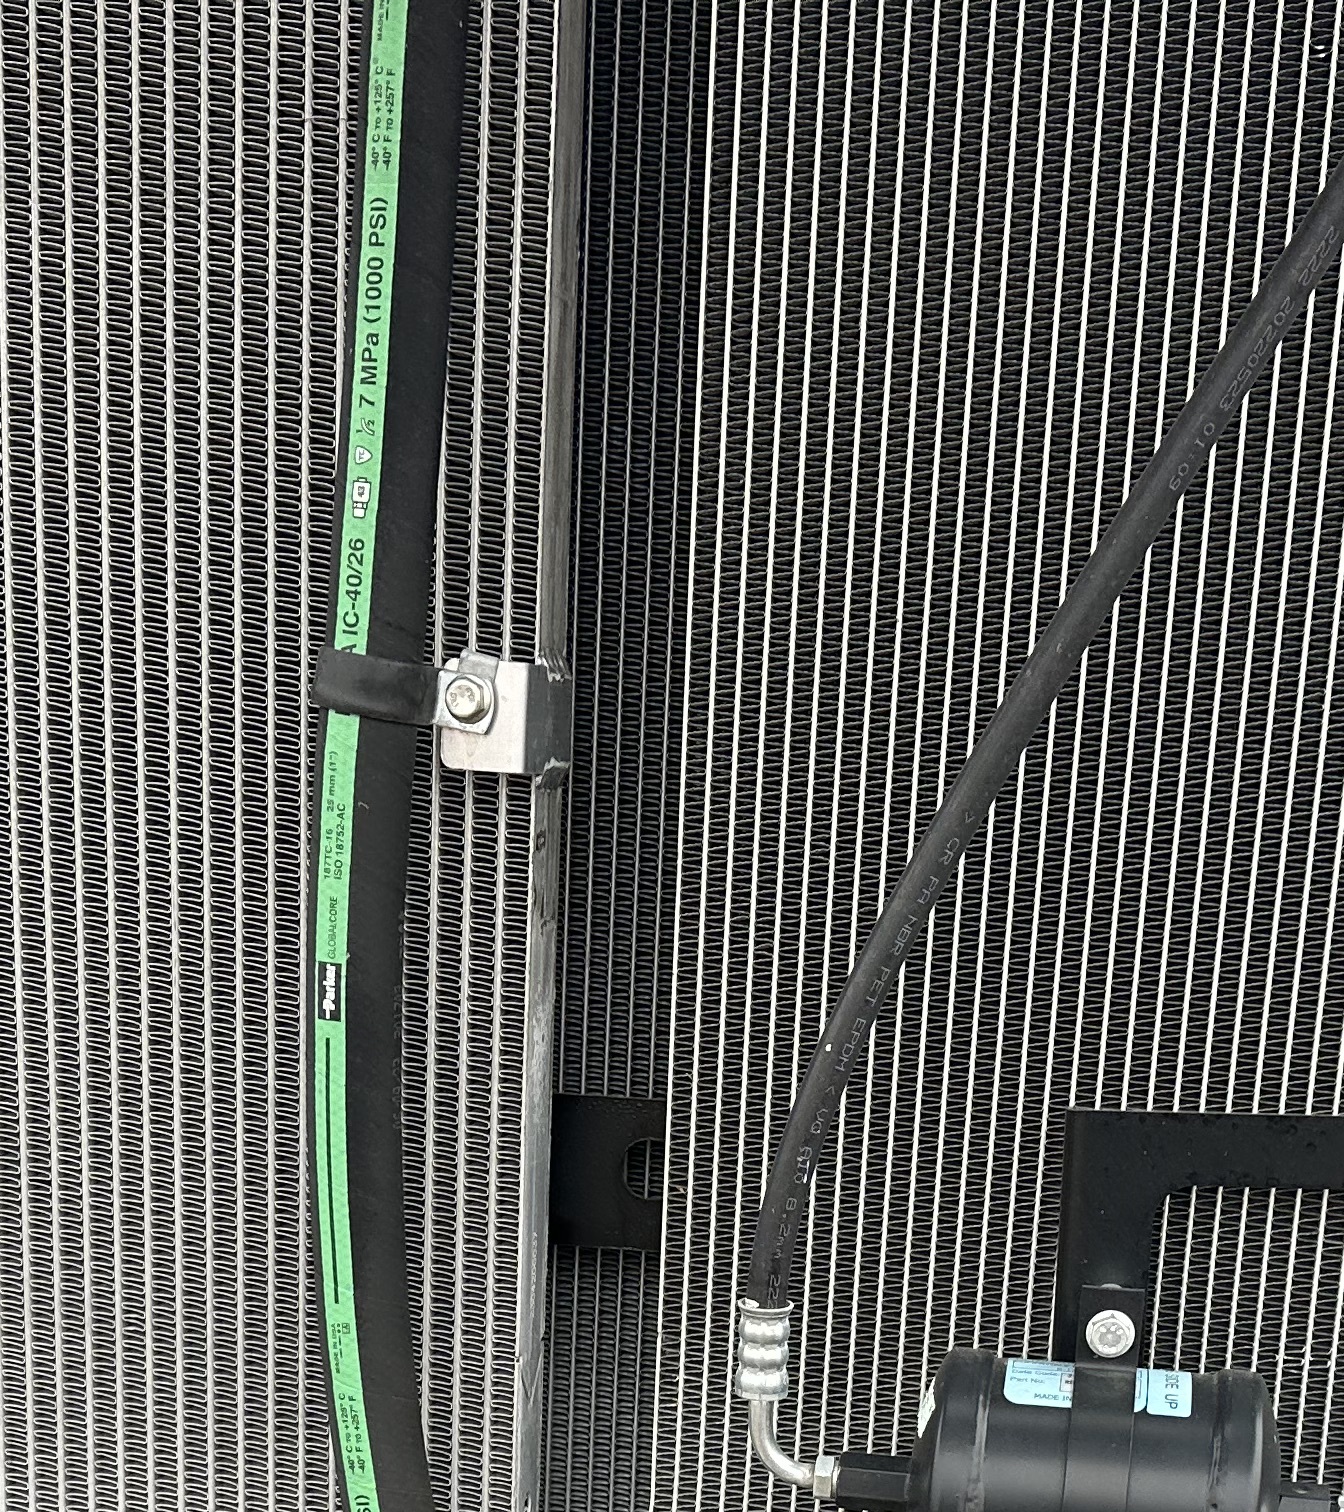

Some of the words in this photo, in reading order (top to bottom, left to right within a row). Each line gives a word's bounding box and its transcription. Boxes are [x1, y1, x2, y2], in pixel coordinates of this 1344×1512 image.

[386, 67, 395, 76] F
[372, 134, 381, 143] C
[369, 197, 389, 247] PSI)
[1297, 226, 1339, 286] 2222
[363, 256, 384, 323] (1000
[360, 332, 380, 386] MPa
[1218, 296, 1295, 411] 20220523
[359, 394, 375, 408] 7
[342, 538, 365, 636] IC-40/26
[335, 803, 346, 857] 18752-AC
[334, 858, 343, 881] ISO
[890, 915, 916, 955] NBR
[322, 962, 337, 1019] Parker
[865, 966, 890, 1005] PET
[836, 1017, 864, 1071] EPDM
[1165, 1394, 1178, 1410] UP
